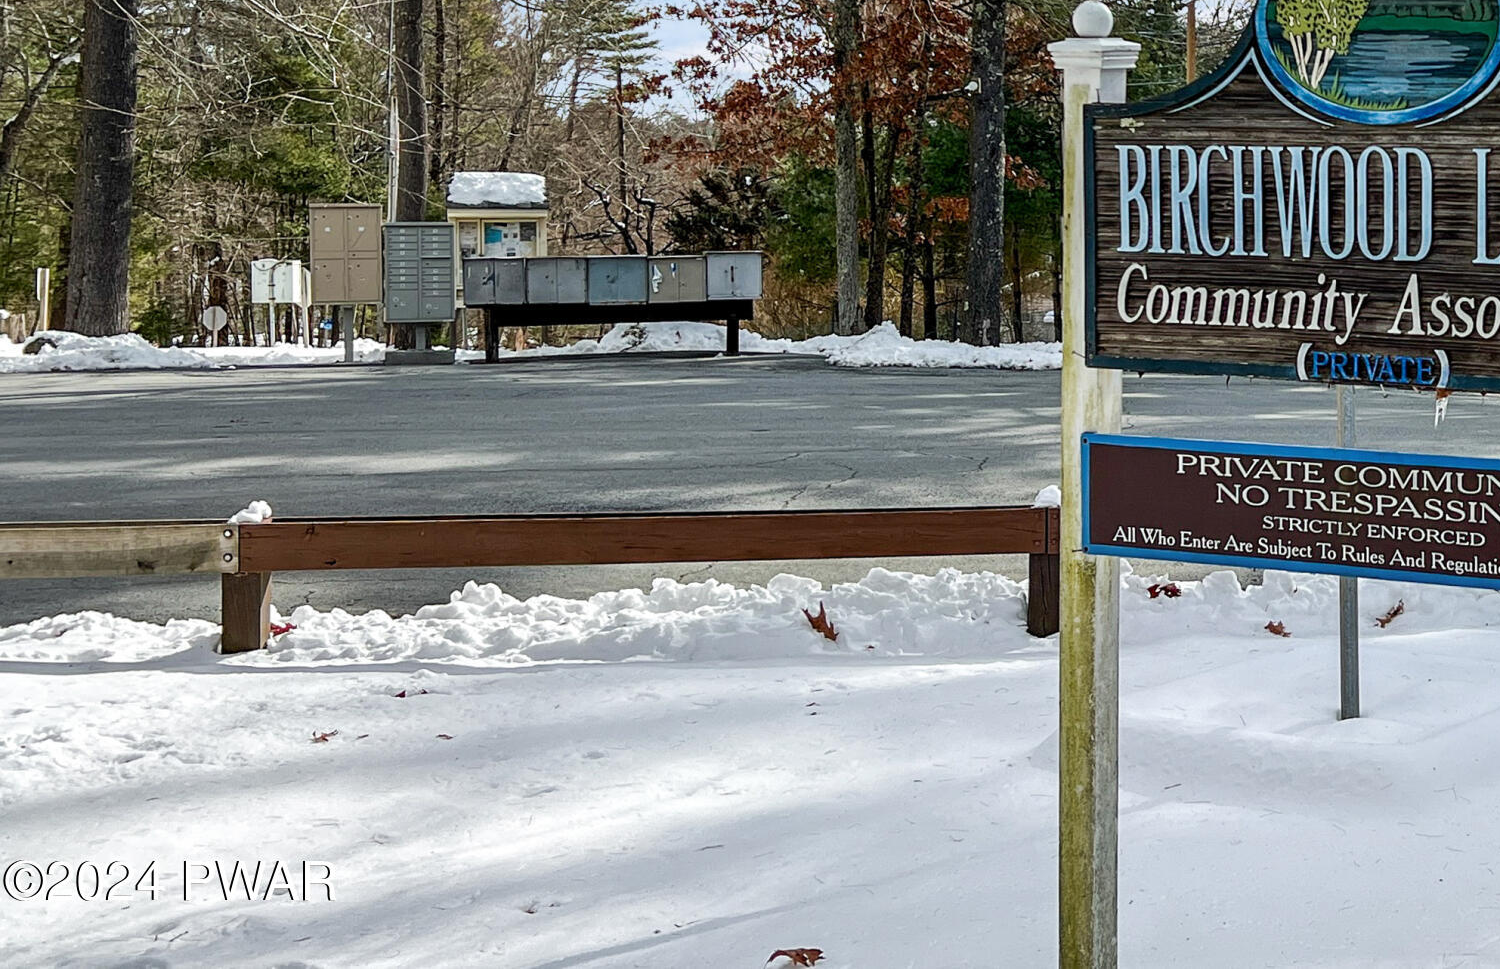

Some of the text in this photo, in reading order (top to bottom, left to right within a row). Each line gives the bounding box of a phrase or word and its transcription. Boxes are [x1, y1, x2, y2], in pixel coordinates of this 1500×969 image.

[1116, 144, 1433, 262] BIRCHWOOD
[1117, 263, 1372, 344] Community
[1177, 454, 1325, 484] PRIVATE
[1216, 483, 1269, 507] NO
[1113, 526, 1136, 542] All
[1140, 528, 1176, 548] Who
[1180, 531, 1221, 552] Enter
[1225, 535, 1253, 553] Are
[1258, 537, 1315, 562] Subject
[1317, 542, 1337, 559] To
[1342, 543, 1385, 566] Rules
[1389, 548, 1425, 569] And
[1262, 516, 1486, 547] STRICTLY ENFORCED
